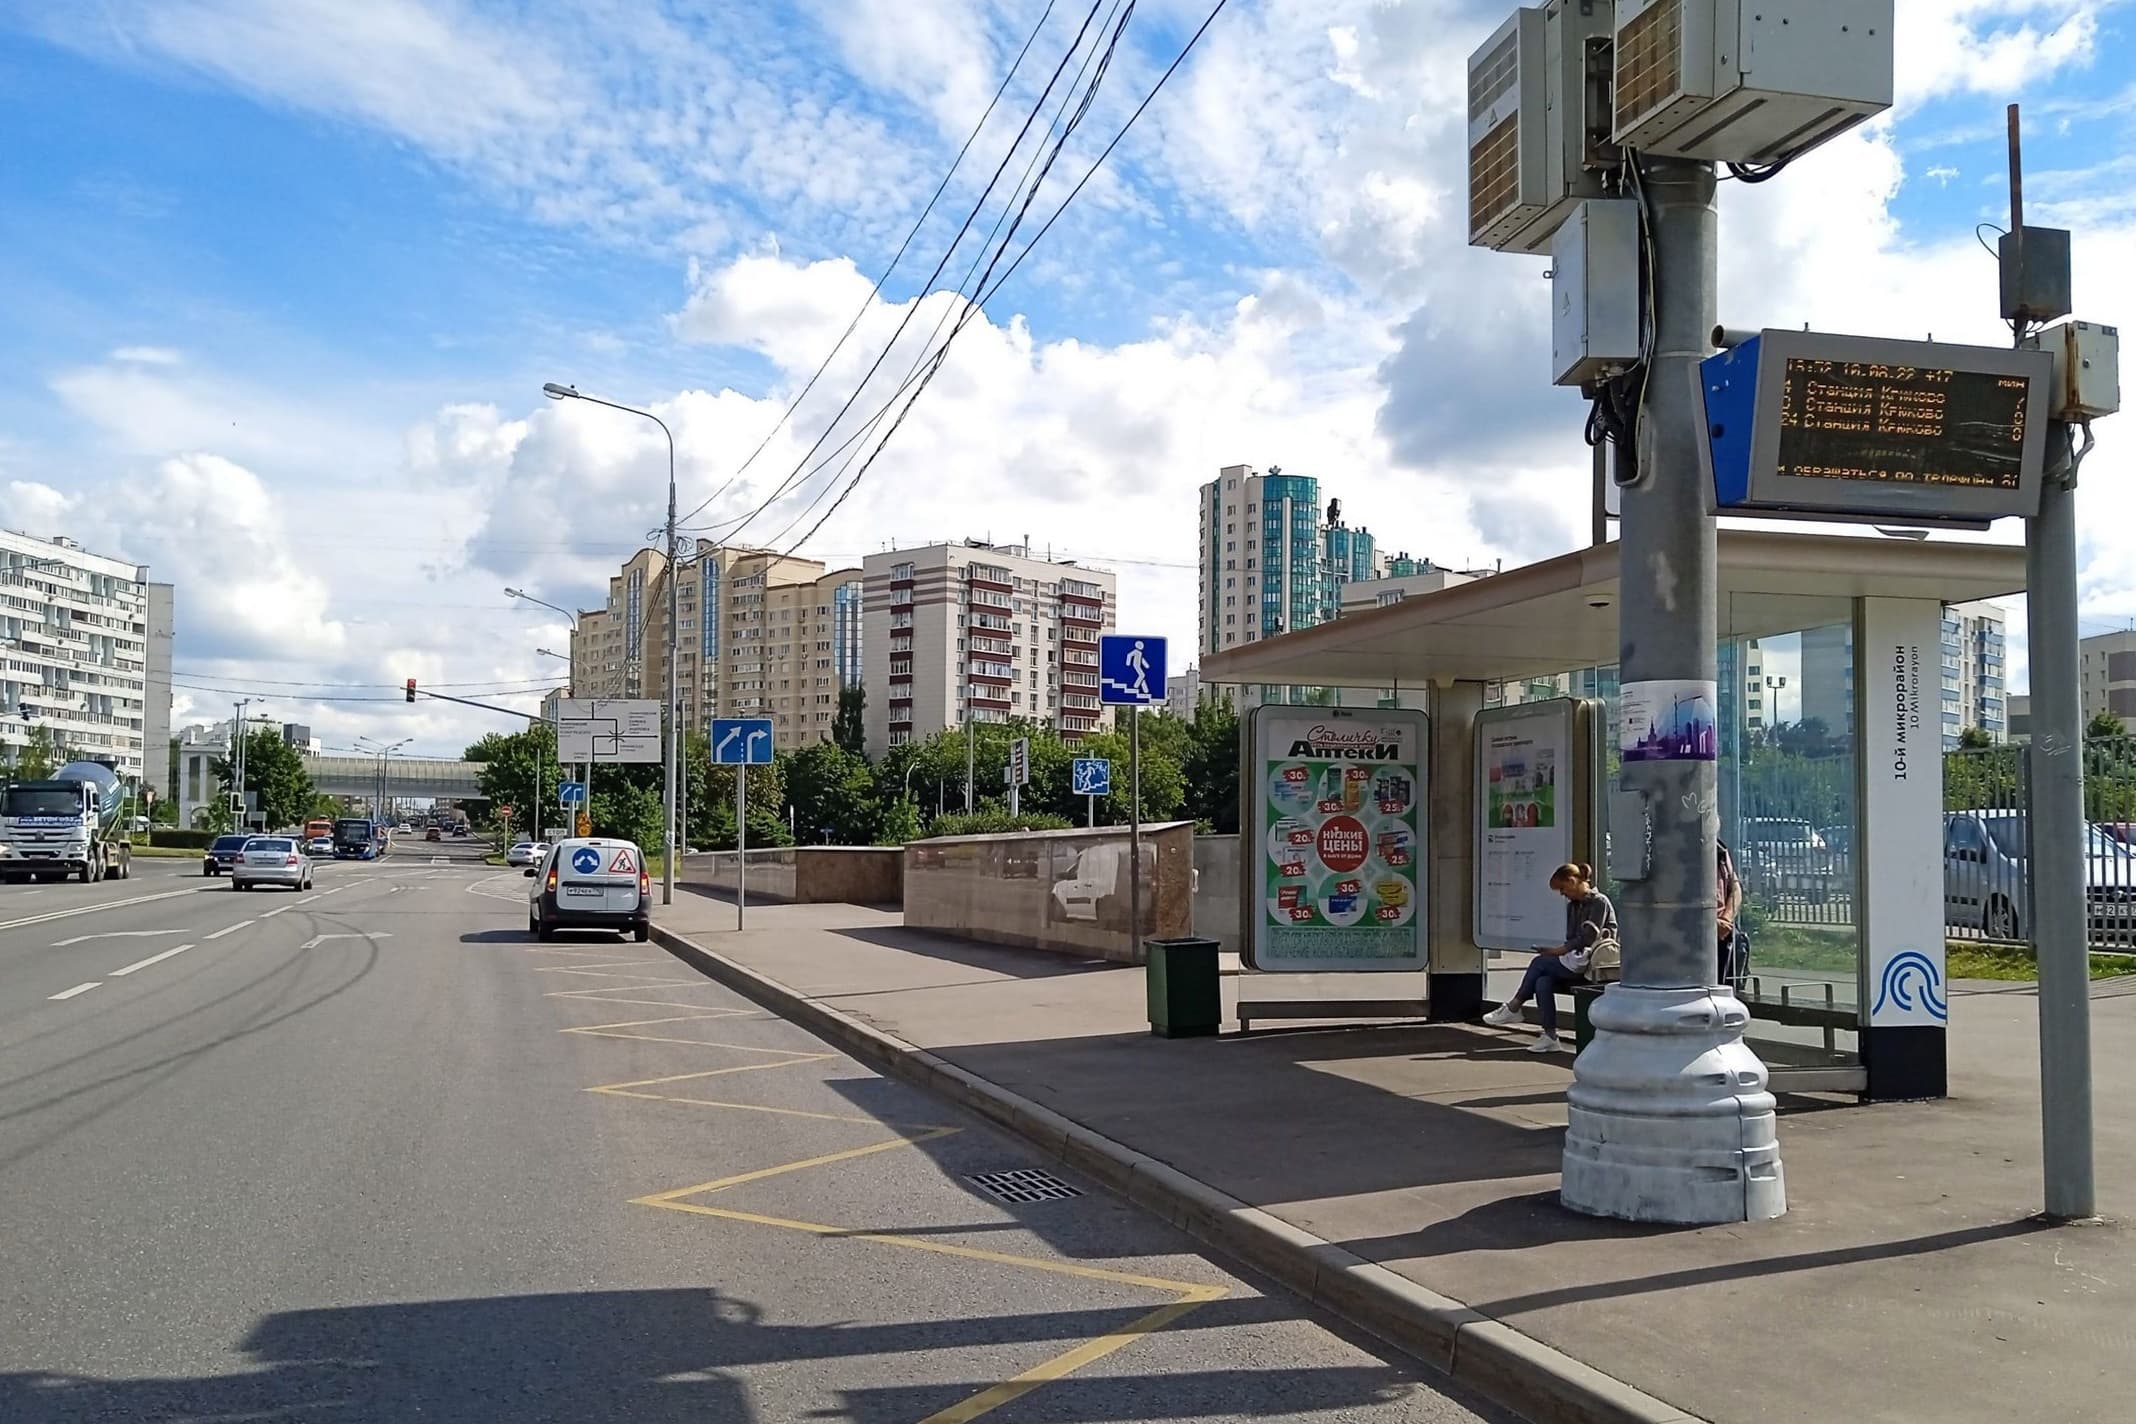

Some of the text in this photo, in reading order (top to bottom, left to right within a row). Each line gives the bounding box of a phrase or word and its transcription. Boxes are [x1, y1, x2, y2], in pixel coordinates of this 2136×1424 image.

[1807, 380, 1873, 399] Станция
[1806, 397, 1872, 415] Станция
[1880, 401, 1944, 420] Крюково
[1804, 413, 1870, 431] Станция
[1909, 646, 1920, 729] 10 Mikrorayon
[1893, 645, 1908, 780] 10-й микрорайон
[1323, 829, 1363, 840] НИЗКИЕ
[1323, 840, 1363, 853] ЦЕНЫ
